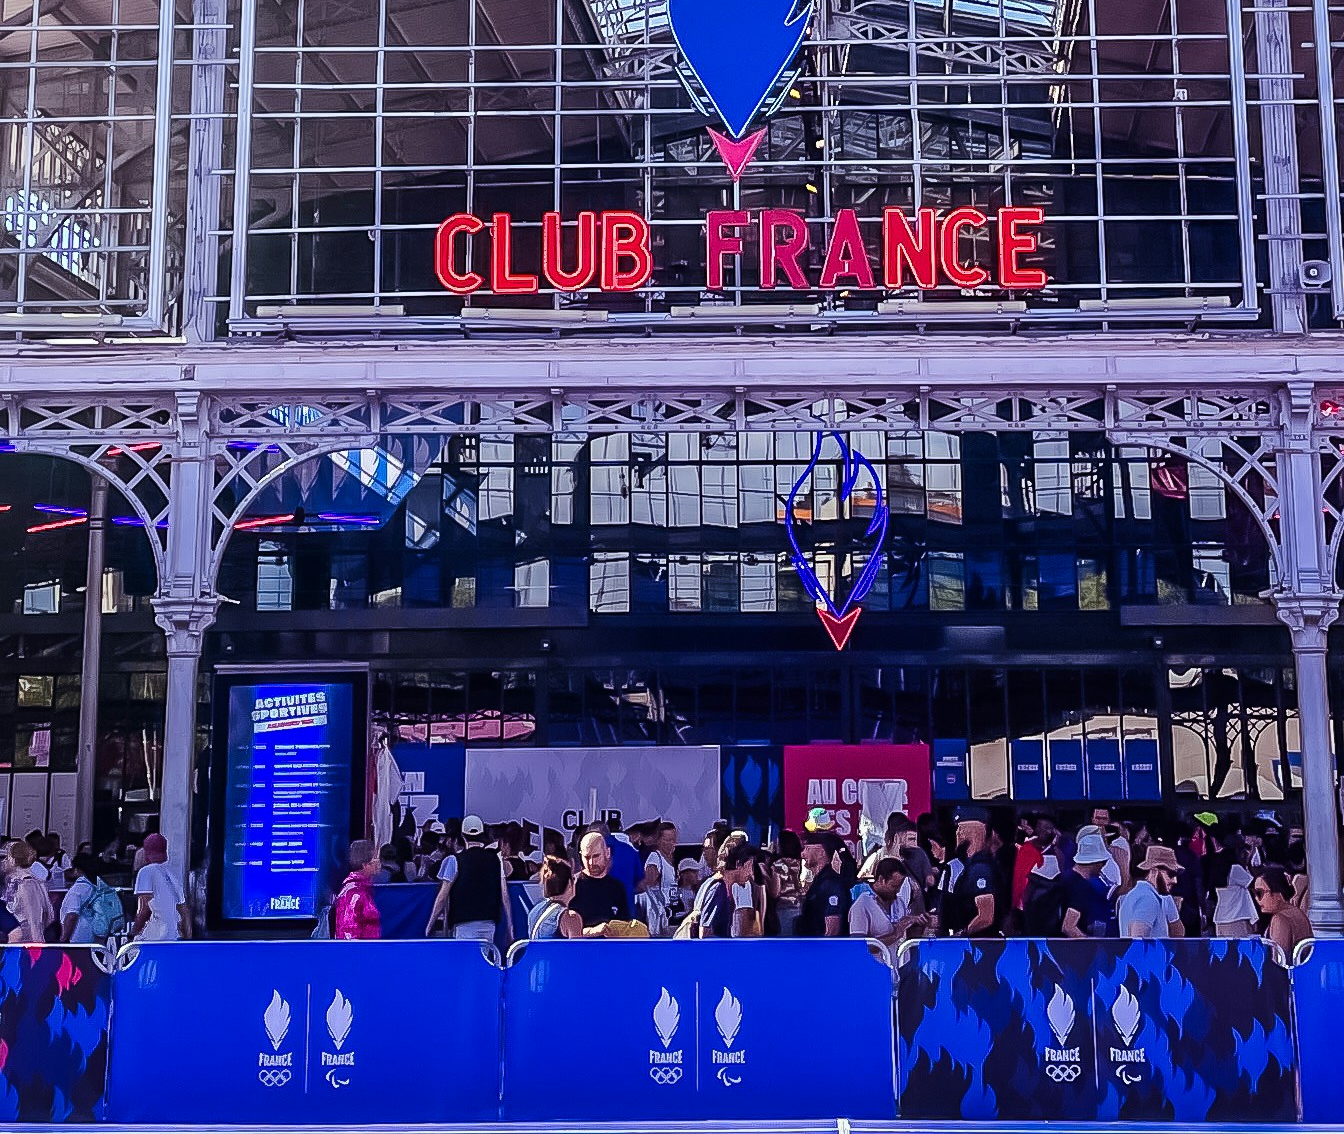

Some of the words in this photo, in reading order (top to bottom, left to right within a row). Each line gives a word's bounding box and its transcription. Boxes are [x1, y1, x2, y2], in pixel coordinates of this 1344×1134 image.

[434, 210, 654, 295] CLUB
[705, 206, 1047, 291] FRANCE
[807, 779, 837, 804] AU
[259, 1052, 292, 1066] FRANCE
[321, 1052, 354, 1065] FRANCE
[650, 1050, 682, 1063] FRANCE
[712, 1050, 745, 1063] FRANCE
[1045, 1047, 1080, 1061] FRANCE
[1110, 1047, 1145, 1062] FRANCE
